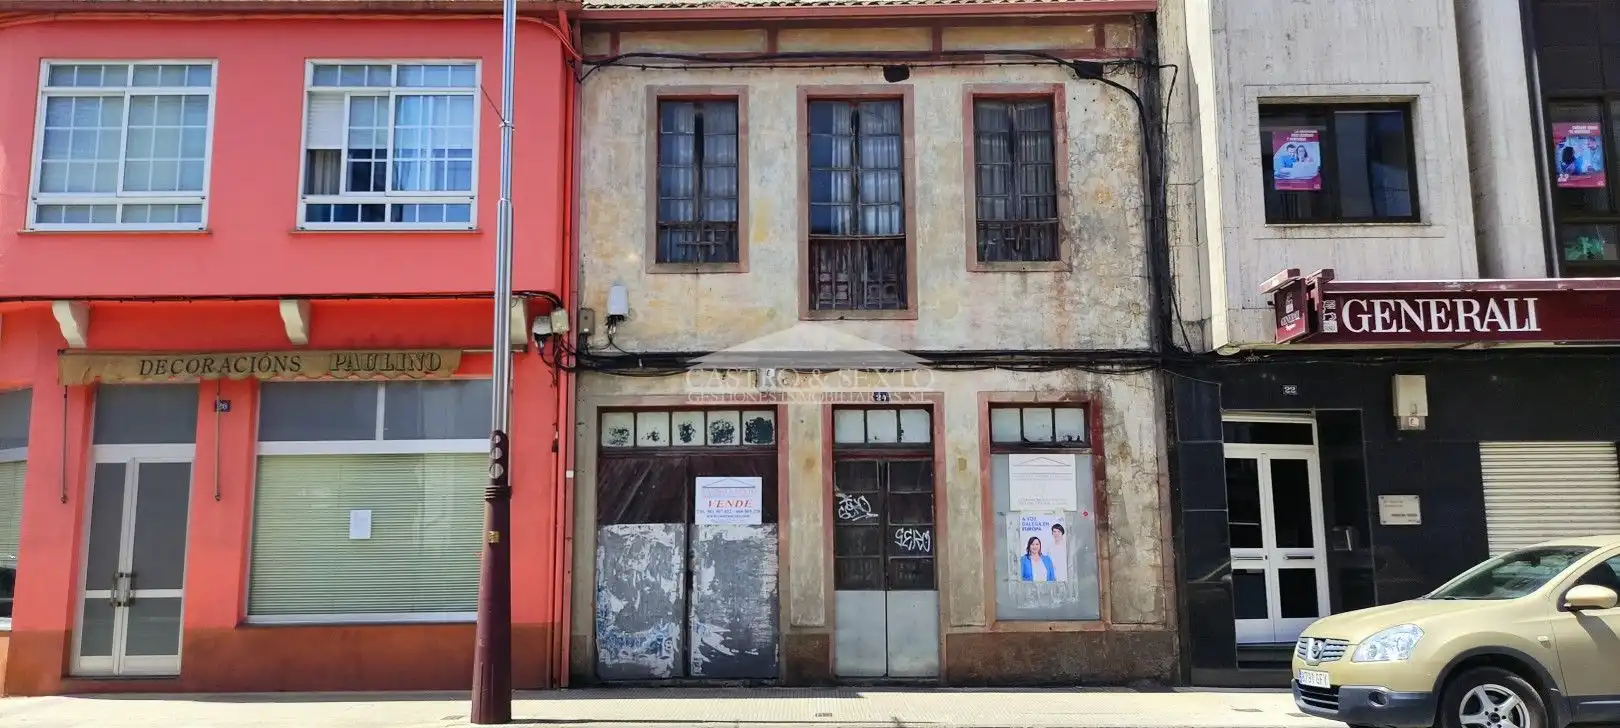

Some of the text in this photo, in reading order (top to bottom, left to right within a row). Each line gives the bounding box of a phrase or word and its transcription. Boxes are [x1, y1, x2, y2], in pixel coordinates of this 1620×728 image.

[1342, 298, 1541, 332] GENERALI
[140, 352, 442, 376] DECORACIÓNS PAULINO
[708, 499, 753, 508] VENDE
